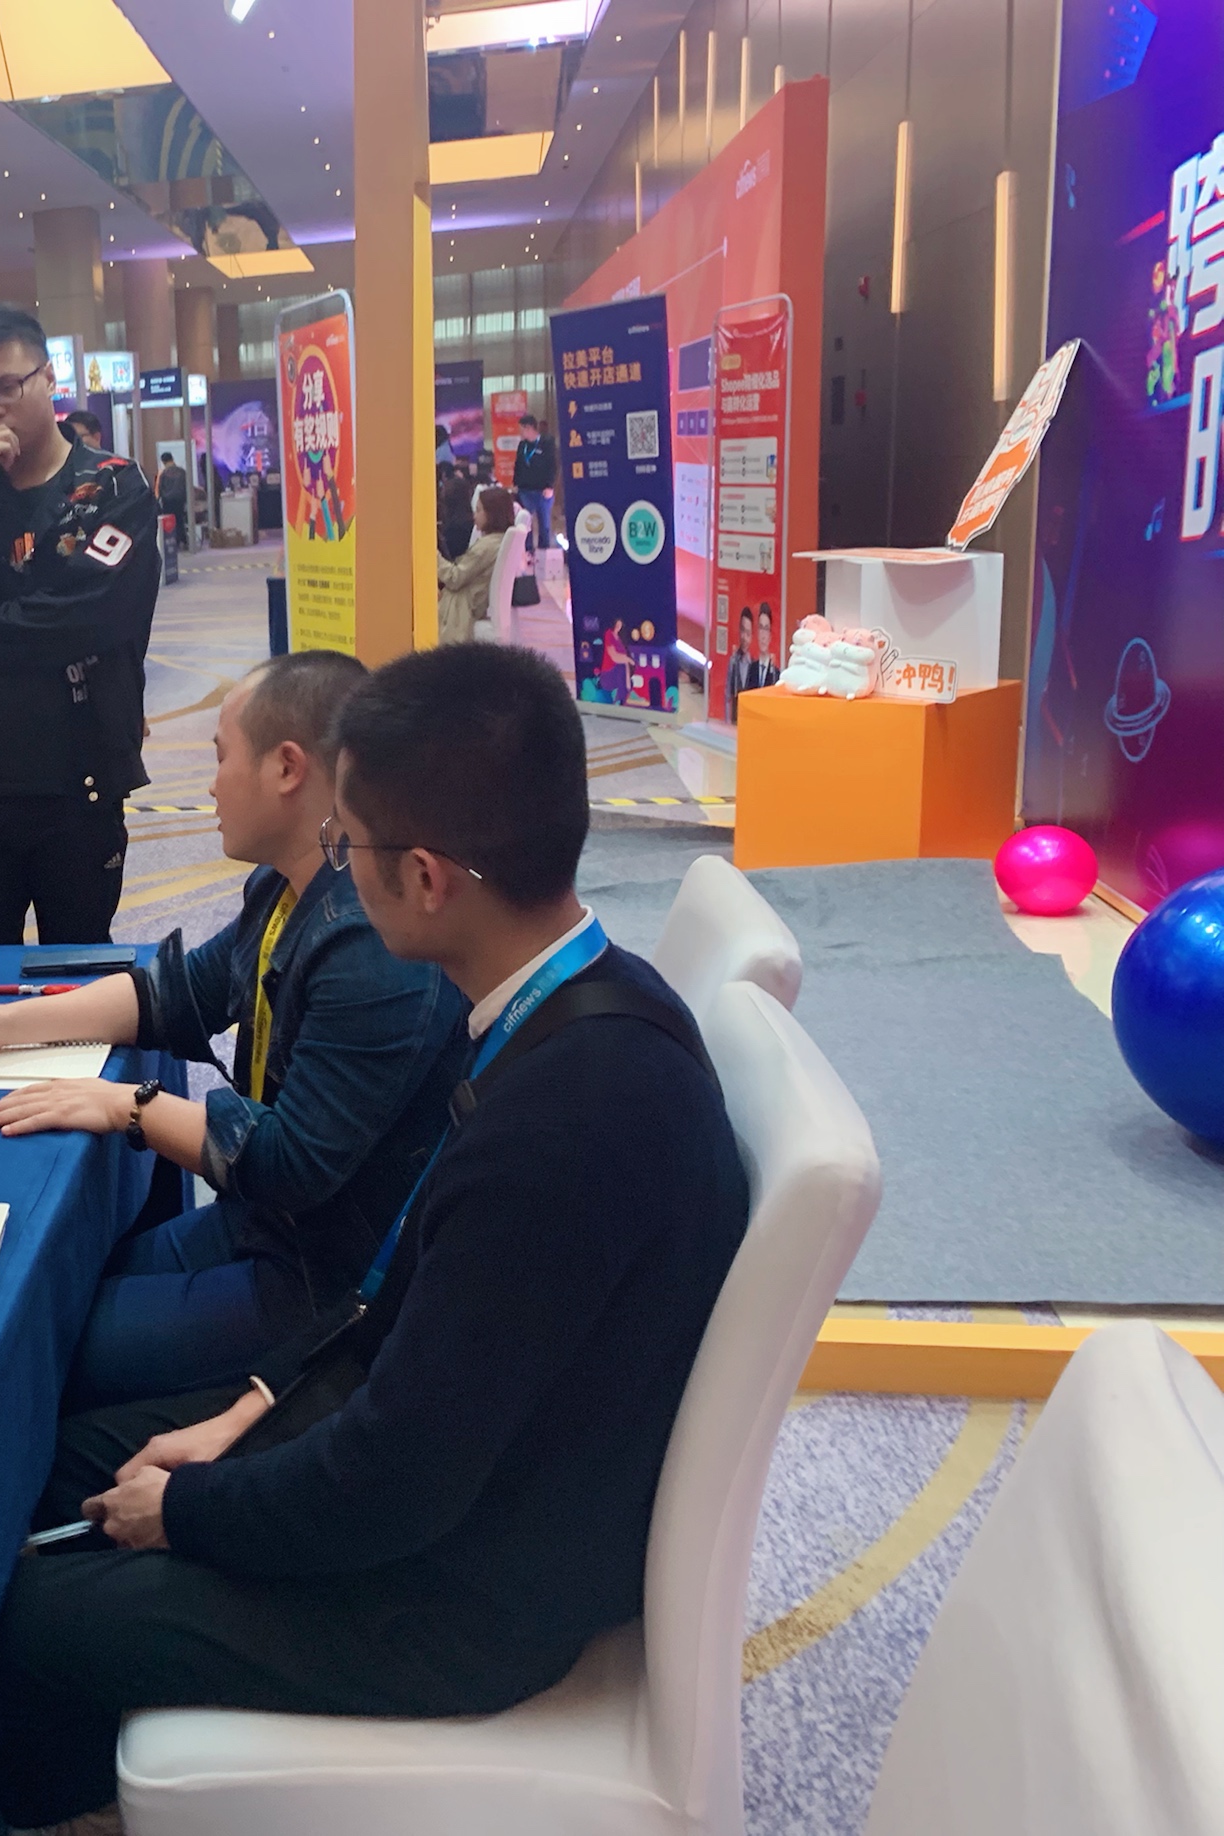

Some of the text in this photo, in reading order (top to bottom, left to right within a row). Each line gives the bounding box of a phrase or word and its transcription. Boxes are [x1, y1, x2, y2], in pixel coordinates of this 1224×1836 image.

[302, 370, 325, 411] 分享
[629, 521, 657, 539] B2W
[503, 987, 542, 1033] cifnews
